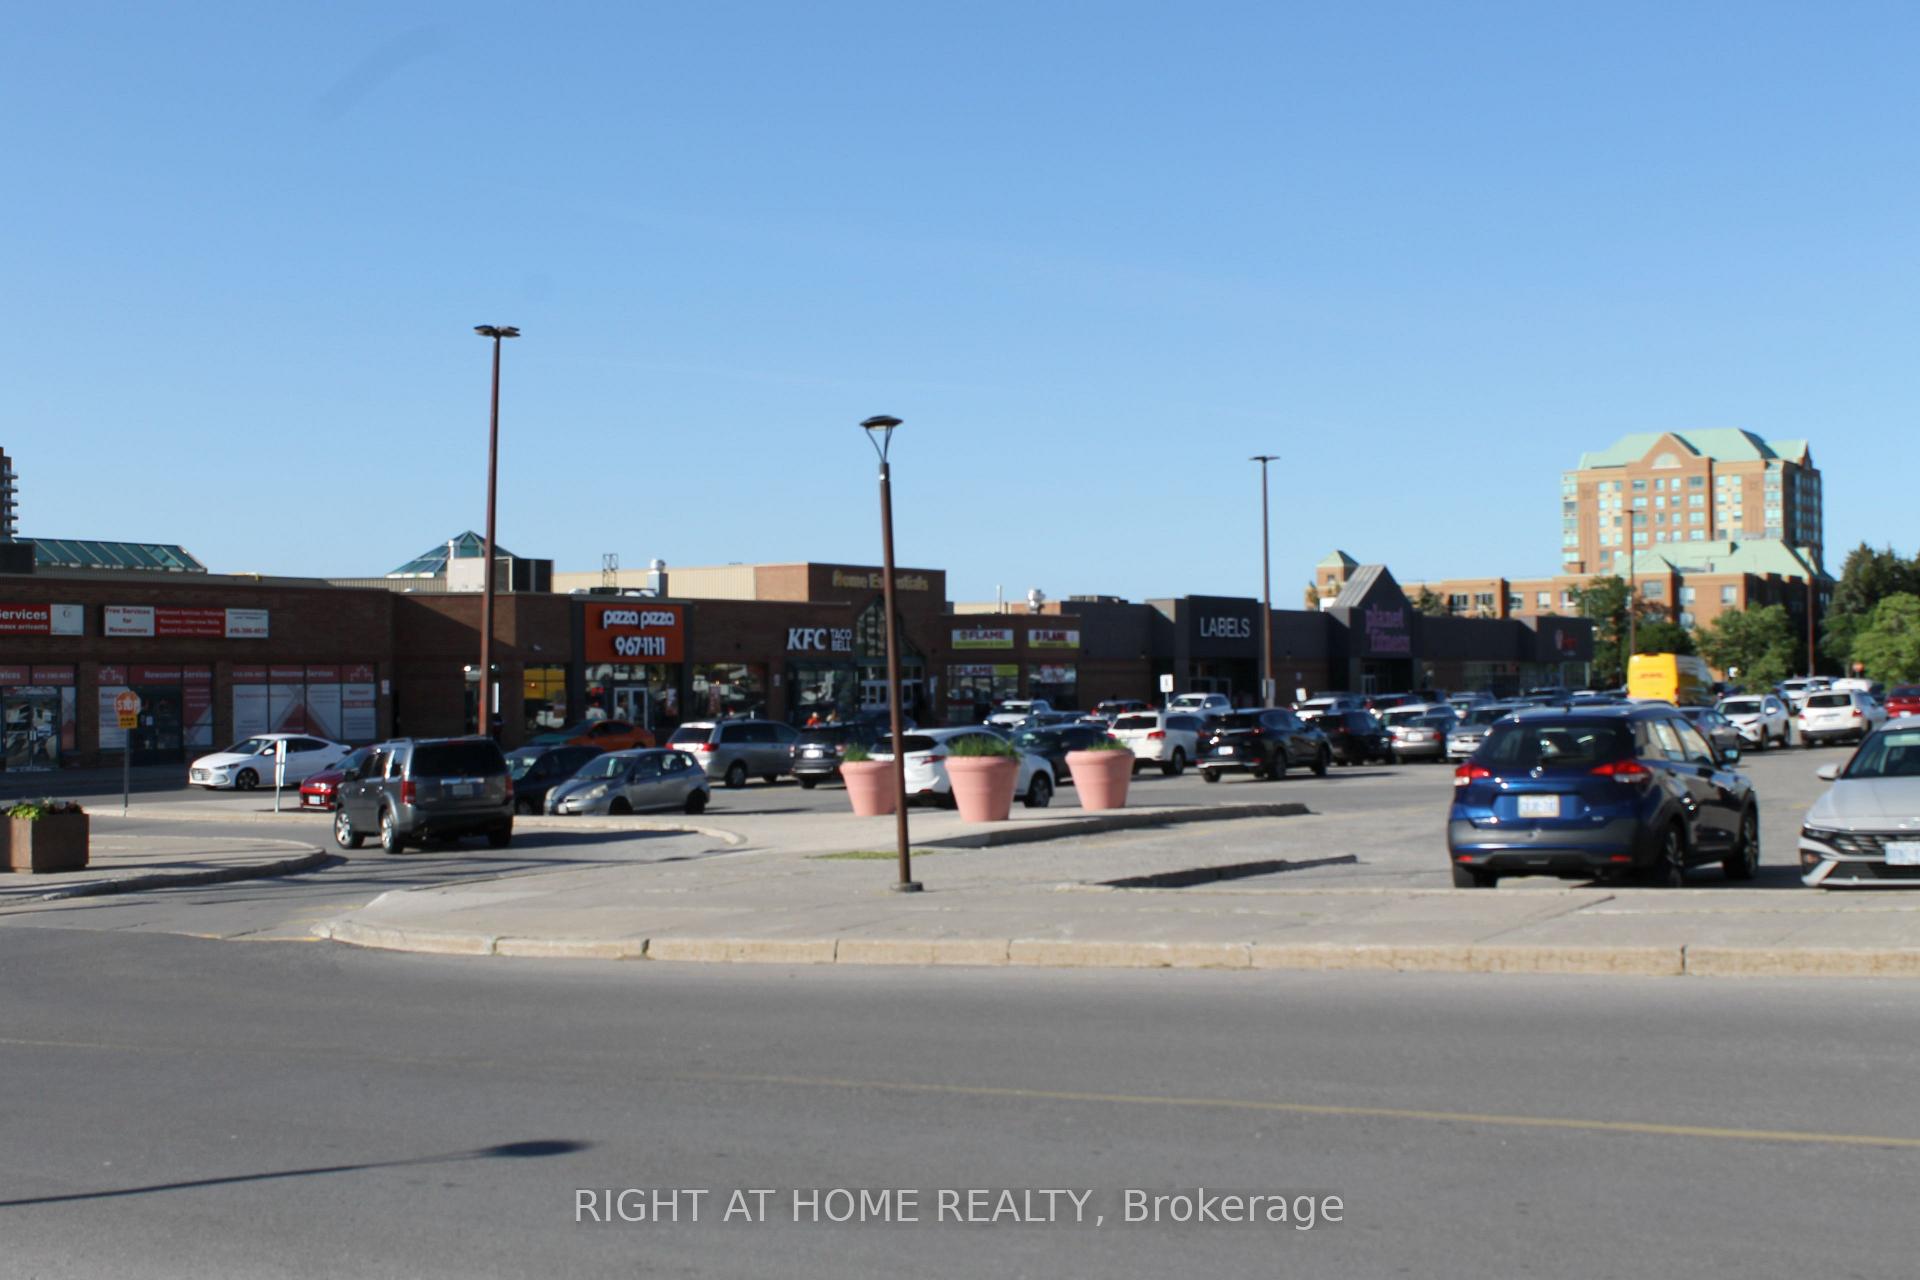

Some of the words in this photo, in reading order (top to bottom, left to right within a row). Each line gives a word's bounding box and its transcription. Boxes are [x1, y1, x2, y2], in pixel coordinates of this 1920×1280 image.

[603, 610, 638, 629] pizza
[641, 611, 675, 630] pizza
[1200, 616, 1250, 638] LABELS
[786, 627, 827, 650] KFC
[830, 628, 852, 639] TACO
[969, 629, 1004, 640] FLAME
[1043, 631, 1066, 641] FLAME
[831, 640, 852, 651] BELL
